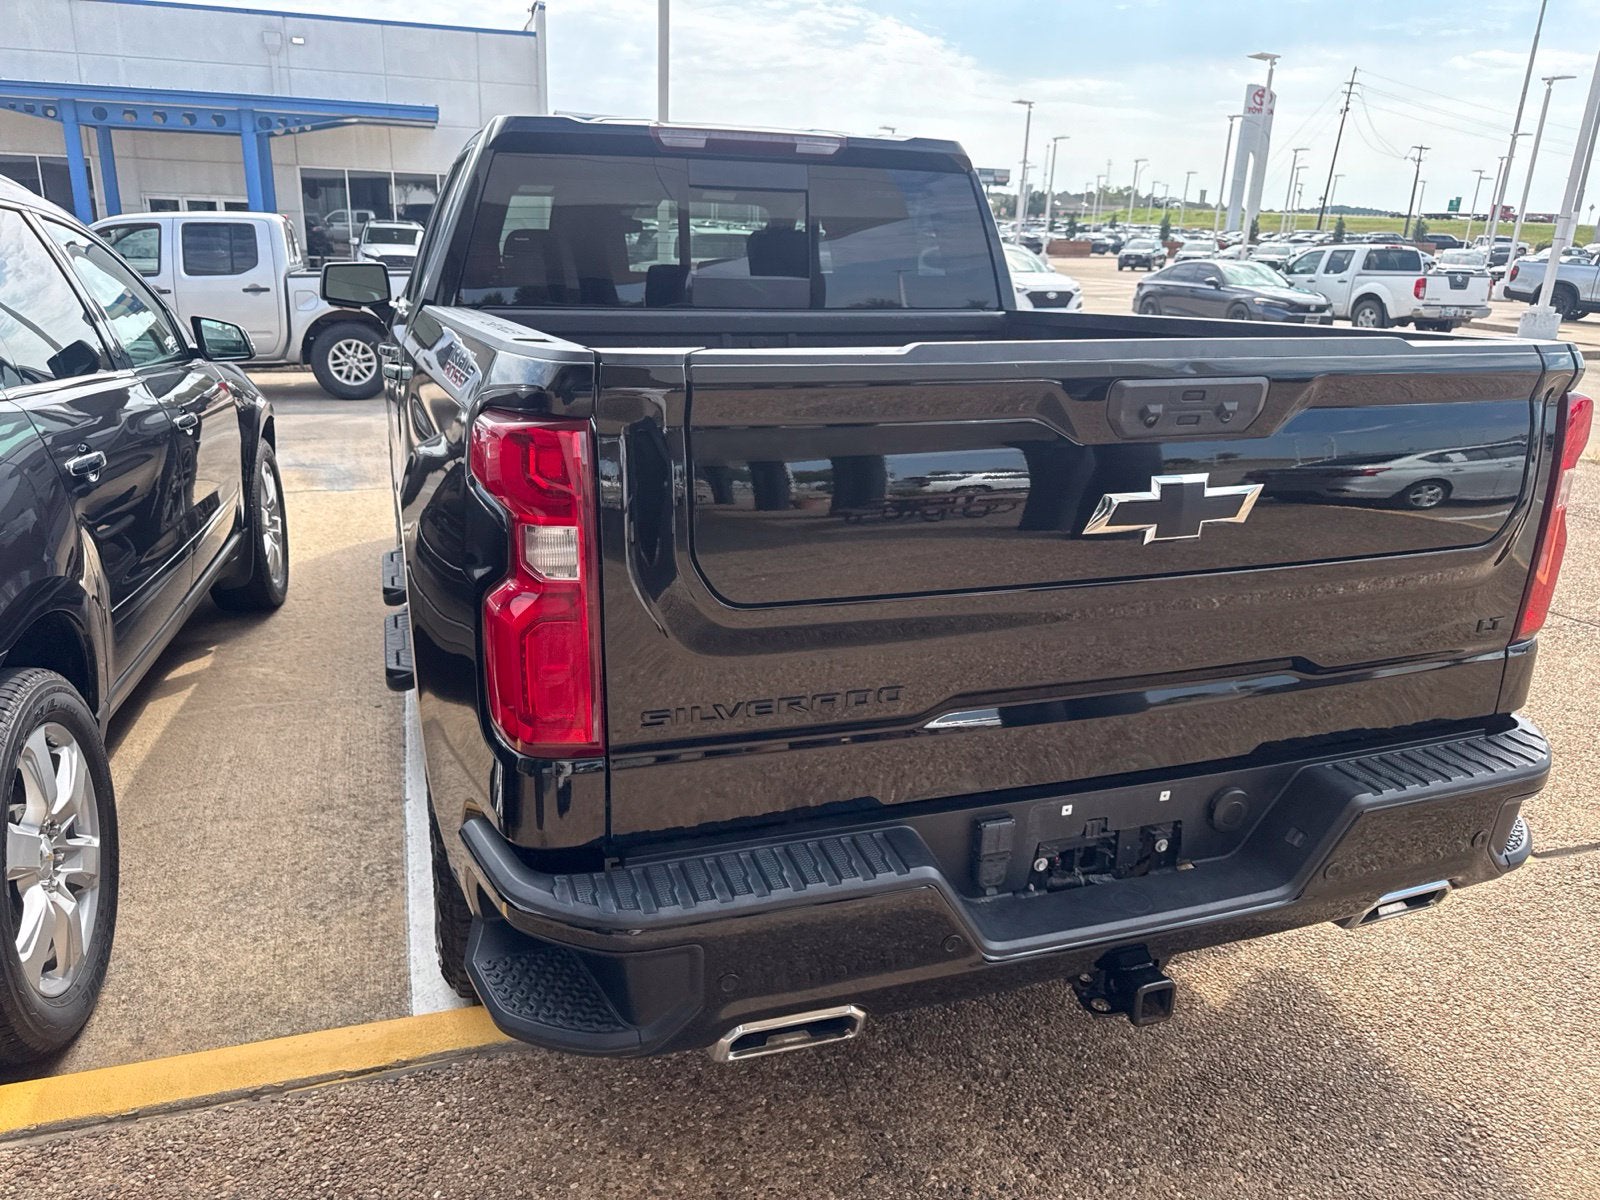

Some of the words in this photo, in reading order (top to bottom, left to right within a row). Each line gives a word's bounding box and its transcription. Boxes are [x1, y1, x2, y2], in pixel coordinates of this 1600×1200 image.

[448, 340, 477, 377] TRAIL
[443, 361, 468, 389] BOSS
[1475, 615, 1505, 633] LT
[640, 685, 905, 729] SILVERADO
